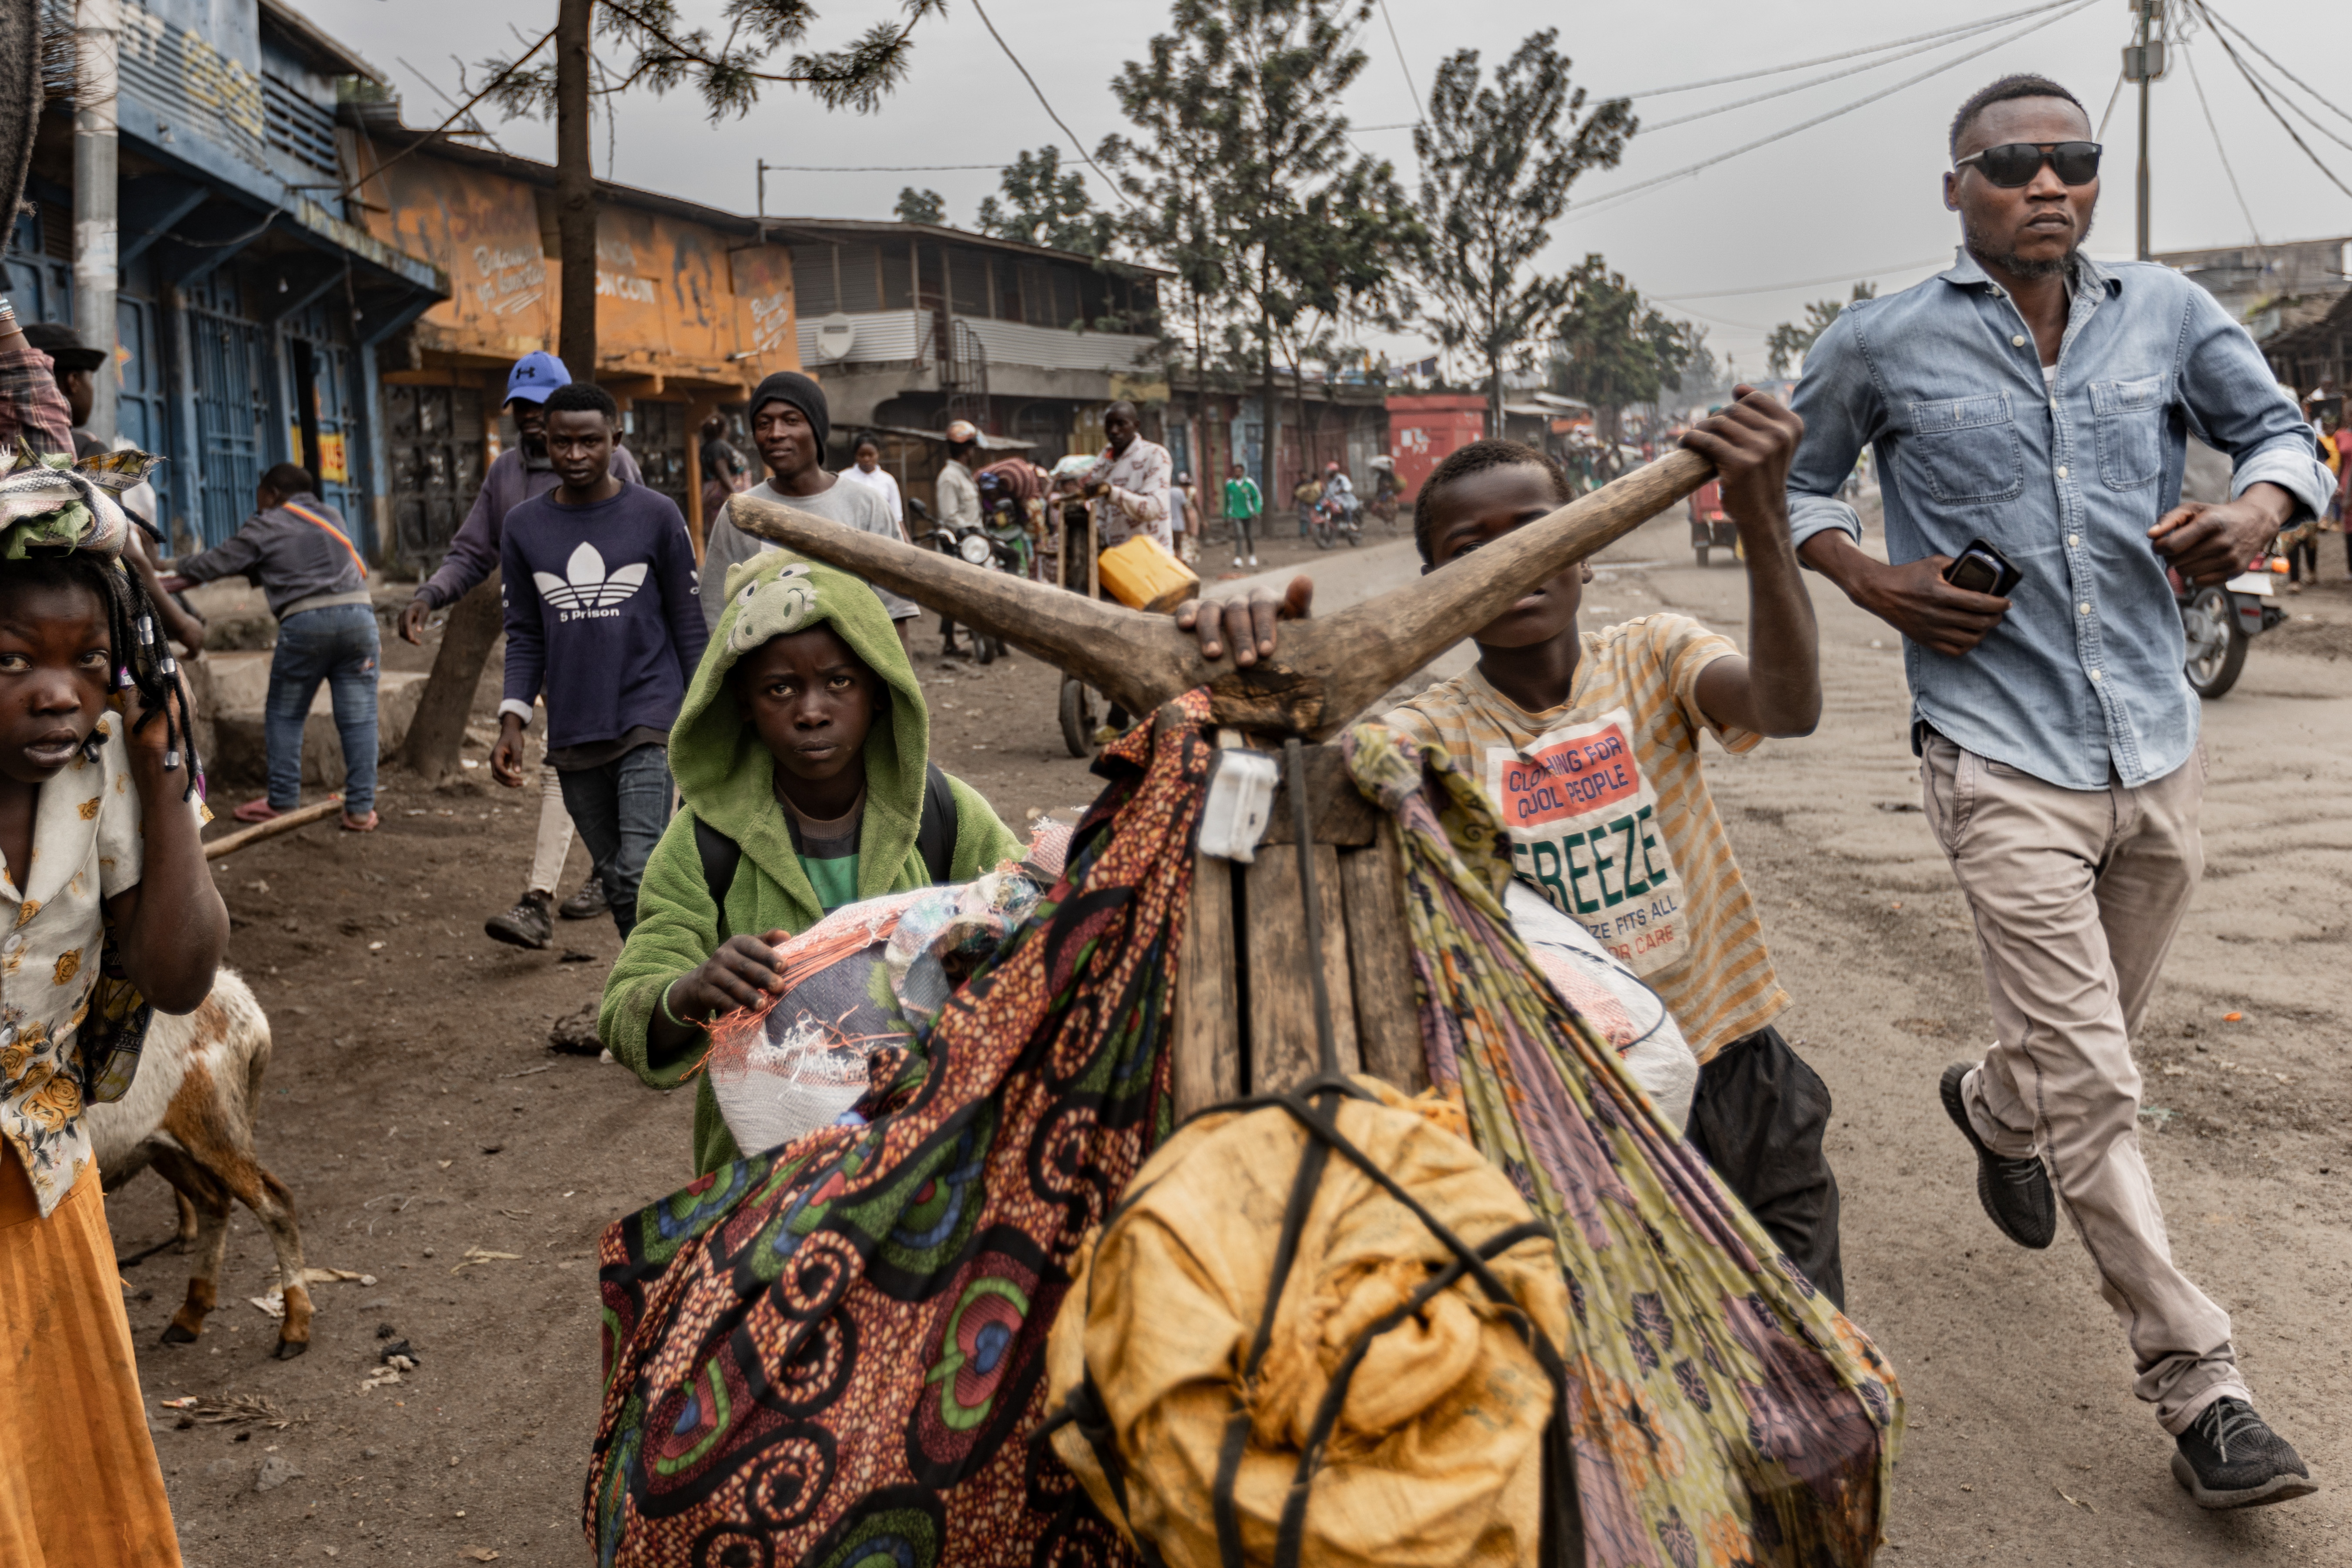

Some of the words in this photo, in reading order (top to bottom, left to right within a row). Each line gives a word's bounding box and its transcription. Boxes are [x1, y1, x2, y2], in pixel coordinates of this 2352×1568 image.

[560, 610, 568, 623] 5
[571, 608, 620, 620] Prison
[1583, 736, 1623, 766] FOR
[1565, 764, 1629, 804] PEOPLE
[1615, 908, 1646, 935] FITS
[1651, 895, 1677, 920] ALL
[1604, 943, 1631, 960] OR
[1635, 924, 1674, 954] CARE
